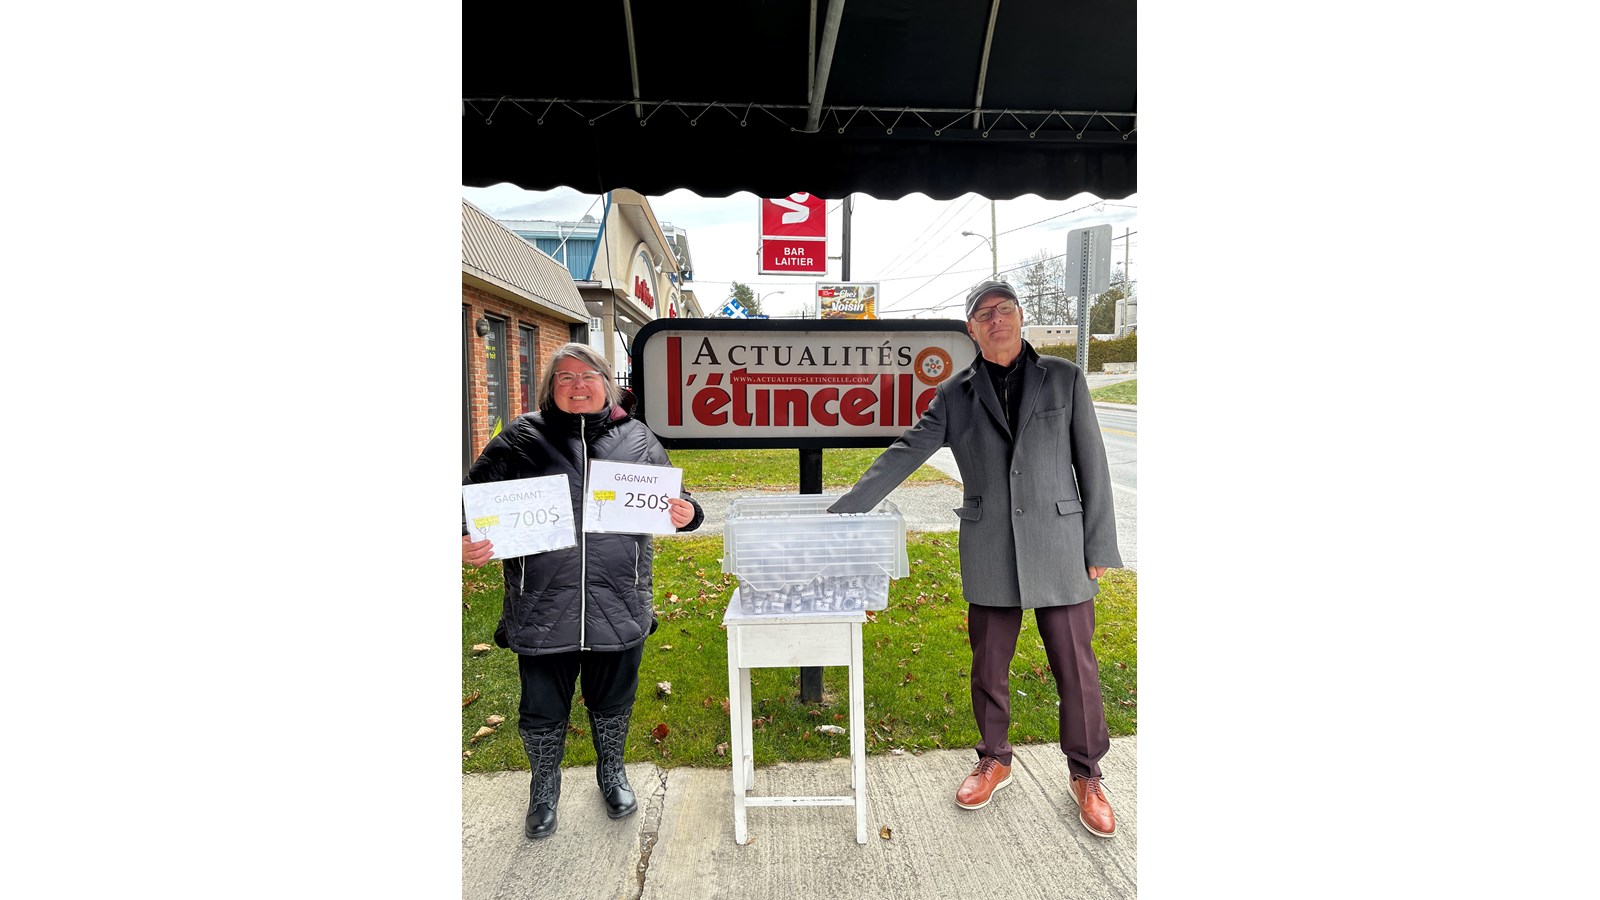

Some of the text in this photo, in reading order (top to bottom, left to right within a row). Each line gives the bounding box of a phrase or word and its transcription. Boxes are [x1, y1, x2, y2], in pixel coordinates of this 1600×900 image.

[784, 247, 805, 256] BAR
[775, 257, 813, 266] LAITIER
[832, 300, 864, 312] Voisin
[692, 336, 912, 366] ACTUALITÉS
[614, 473, 659, 484] GAGNANT
[495, 491, 542, 504] GAGNANT
[624, 492, 669, 512] 250$
[509, 505, 560, 528] 700$
